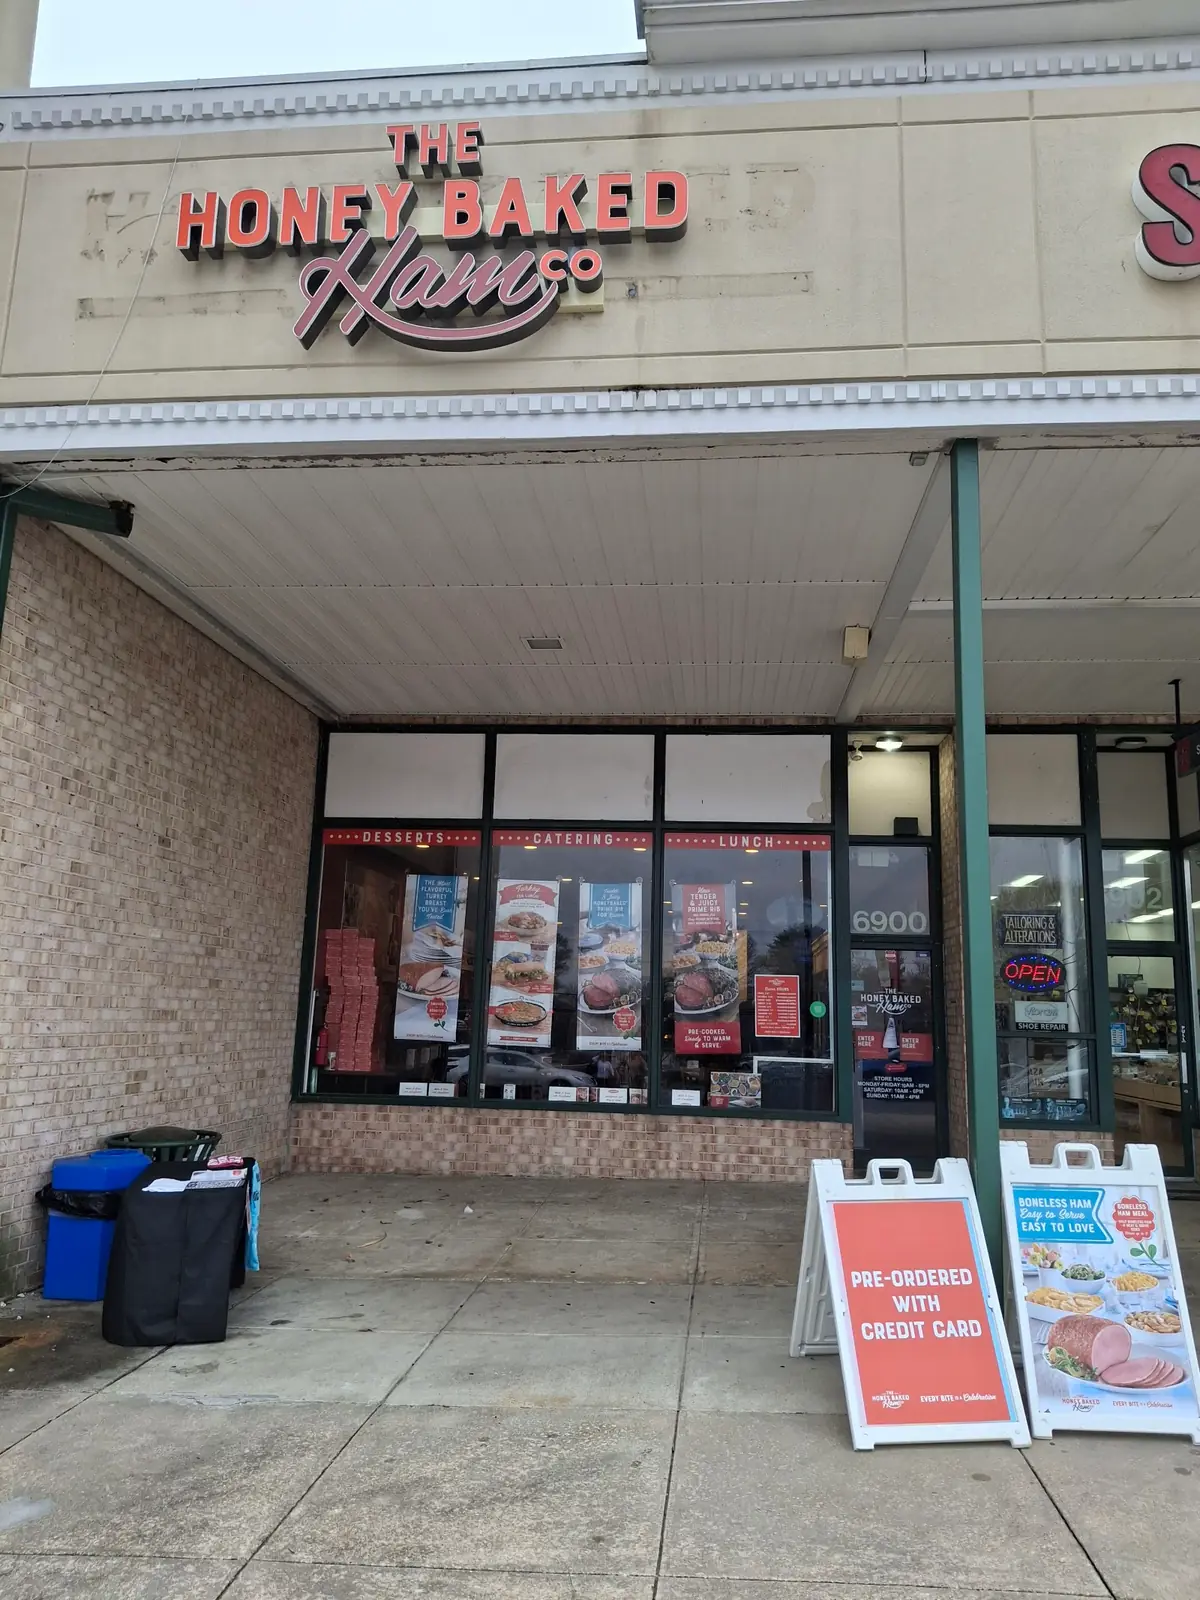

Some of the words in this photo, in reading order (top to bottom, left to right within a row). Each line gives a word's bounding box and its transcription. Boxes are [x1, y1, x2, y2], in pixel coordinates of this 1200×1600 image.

[386, 121, 482, 176] THE
[176, 182, 415, 252] HONEY
[442, 170, 690, 242] BAKED
[292, 226, 559, 352] Ham
[538, 249, 603, 284] CO
[362, 831, 445, 844] DESSERTS
[533, 832, 613, 846] CATERING
[719, 835, 774, 849] LUNCH
[852, 910, 928, 933] 6900
[1005, 916, 1047, 930] TAILORING
[1048, 917, 1055, 930] &
[1005, 930, 1056, 943] ALTERATIONS
[1005, 963, 1061, 983] OPEN
[861, 994, 891, 1002] HONEY
[892, 995, 921, 1004] BAKED
[876, 1000, 907, 1015] Ham
[1019, 1198, 1067, 1208] BONELESS
[1070, 1200, 1092, 1208] HAM
[1020, 1208, 1042, 1220] Easy
[1058, 1210, 1085, 1219] Serve
[1022, 1222, 1046, 1232] EASY
[1051, 1223, 1064, 1232] TO
[1069, 1224, 1095, 1233] LOVE
[851, 1268, 973, 1288] PRE-ORDERED
[894, 1296, 940, 1313] WITH
[861, 1322, 925, 1340] CREDIT
[933, 1320, 982, 1338] CARD
[963, 1393, 996, 1402] Celebration
